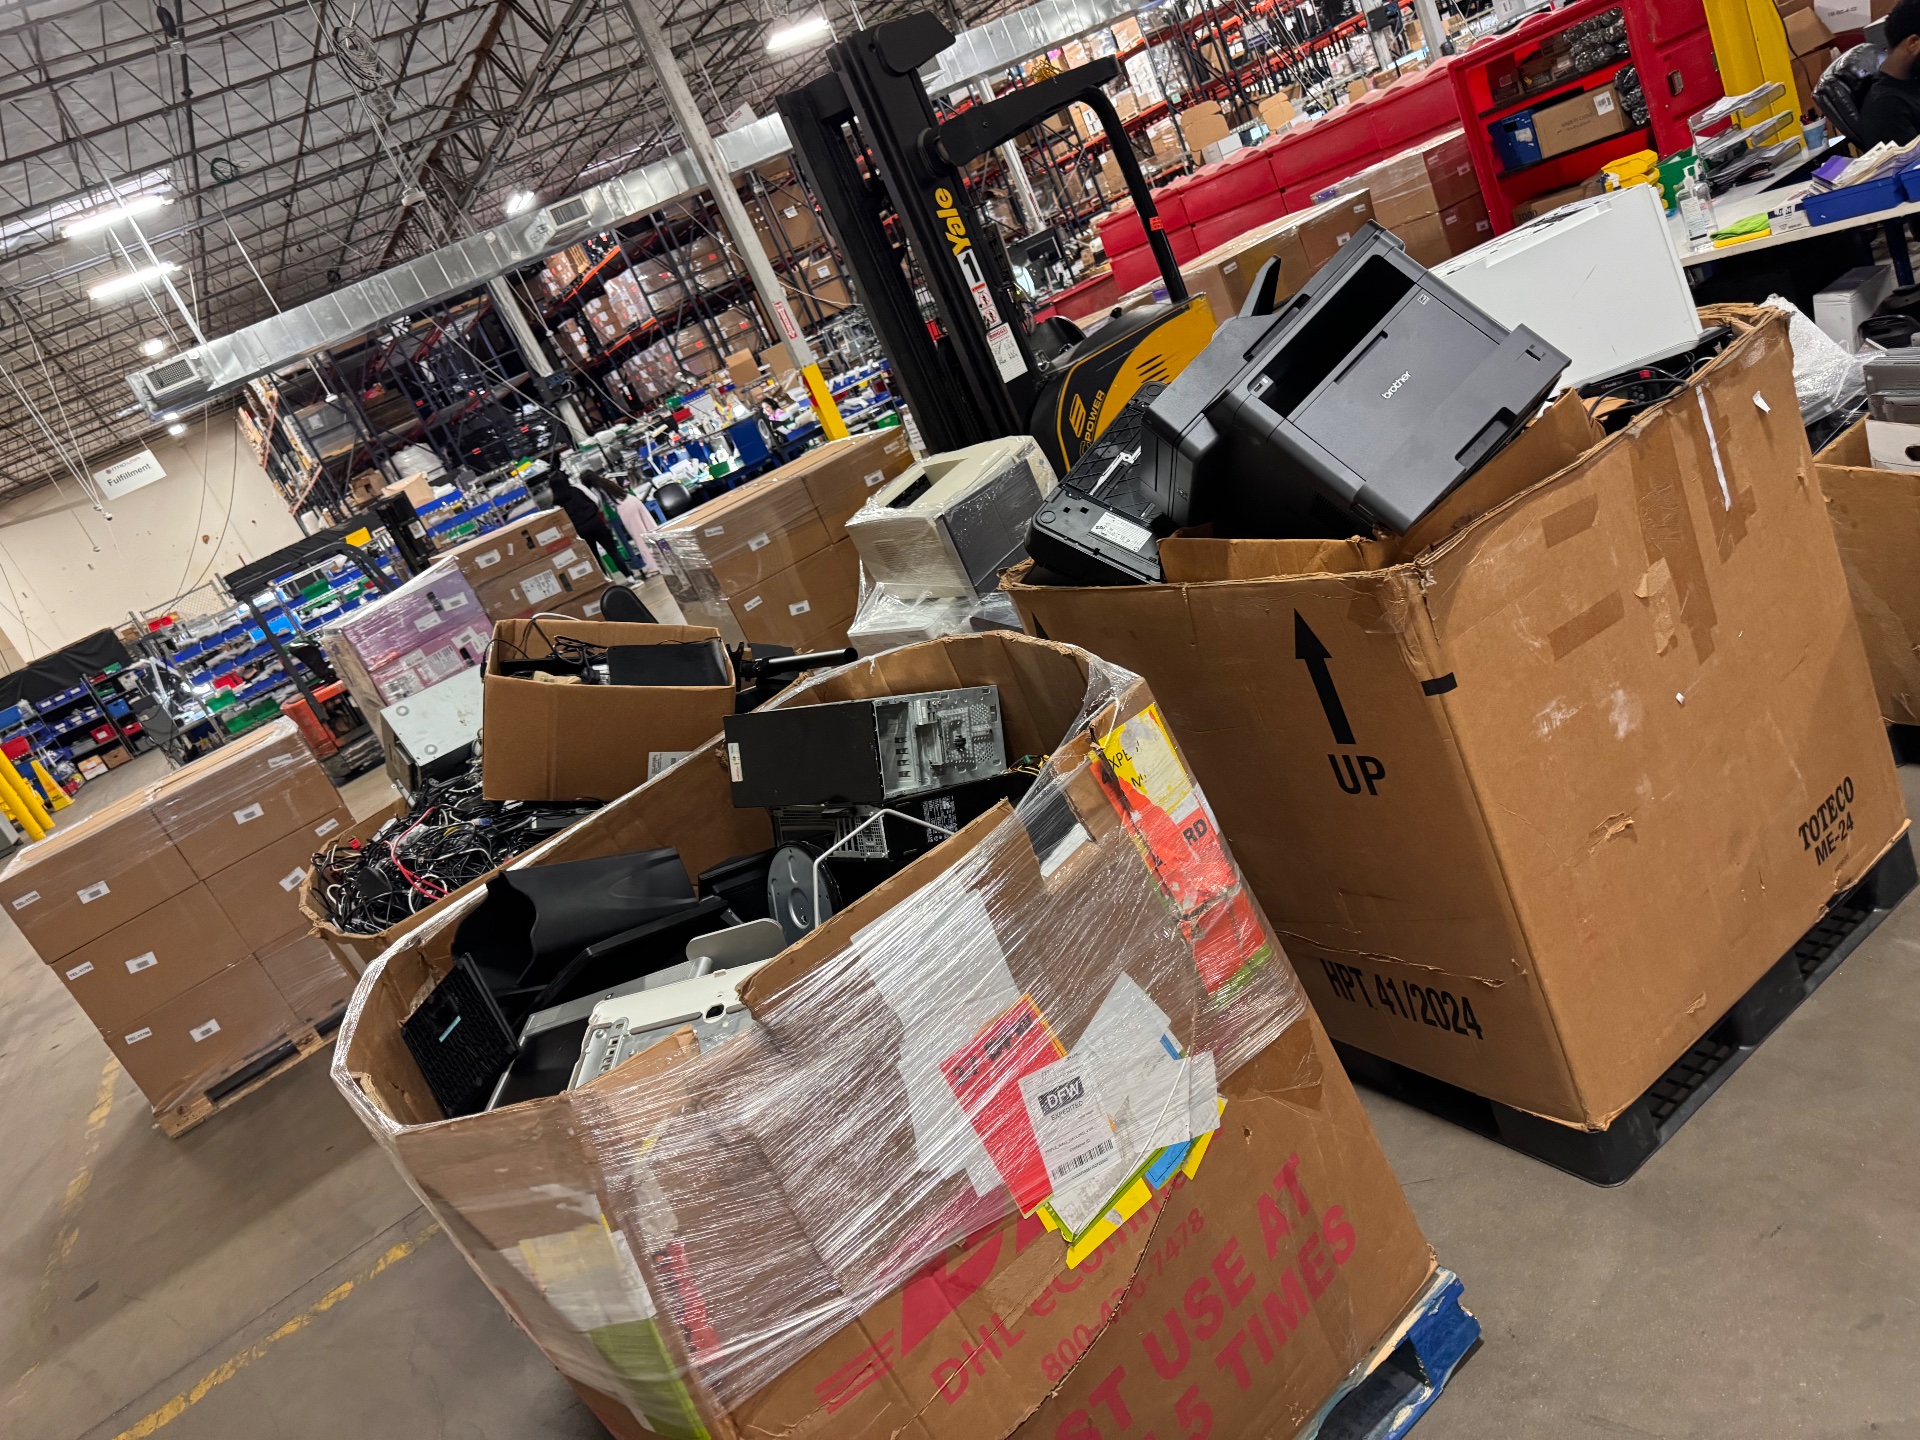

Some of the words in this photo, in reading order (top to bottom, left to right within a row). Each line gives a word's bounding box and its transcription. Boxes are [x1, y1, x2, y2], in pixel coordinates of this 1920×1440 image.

[935, 188, 971, 256] Yale
[1381, 370, 1411, 399] brother
[1084, 389, 1106, 443] POWER
[107, 463, 151, 487] Fulfillment
[1327, 754, 1386, 796] UP
[1798, 776, 1854, 851] TOTECO
[1814, 811, 1854, 867] ME-24
[1374, 973, 1484, 1041] 41/2024
[1046, 1081, 1081, 1108] DFW
[1050, 1100, 1084, 1121] EXPEDITED
[1141, 1236, 1256, 1380] USE
[1257, 1152, 1310, 1262] AT
[1174, 1383, 1214, 1440] 5
[1214, 1205, 1357, 1391] TIMES
[930, 1313, 1027, 1406] DHL
